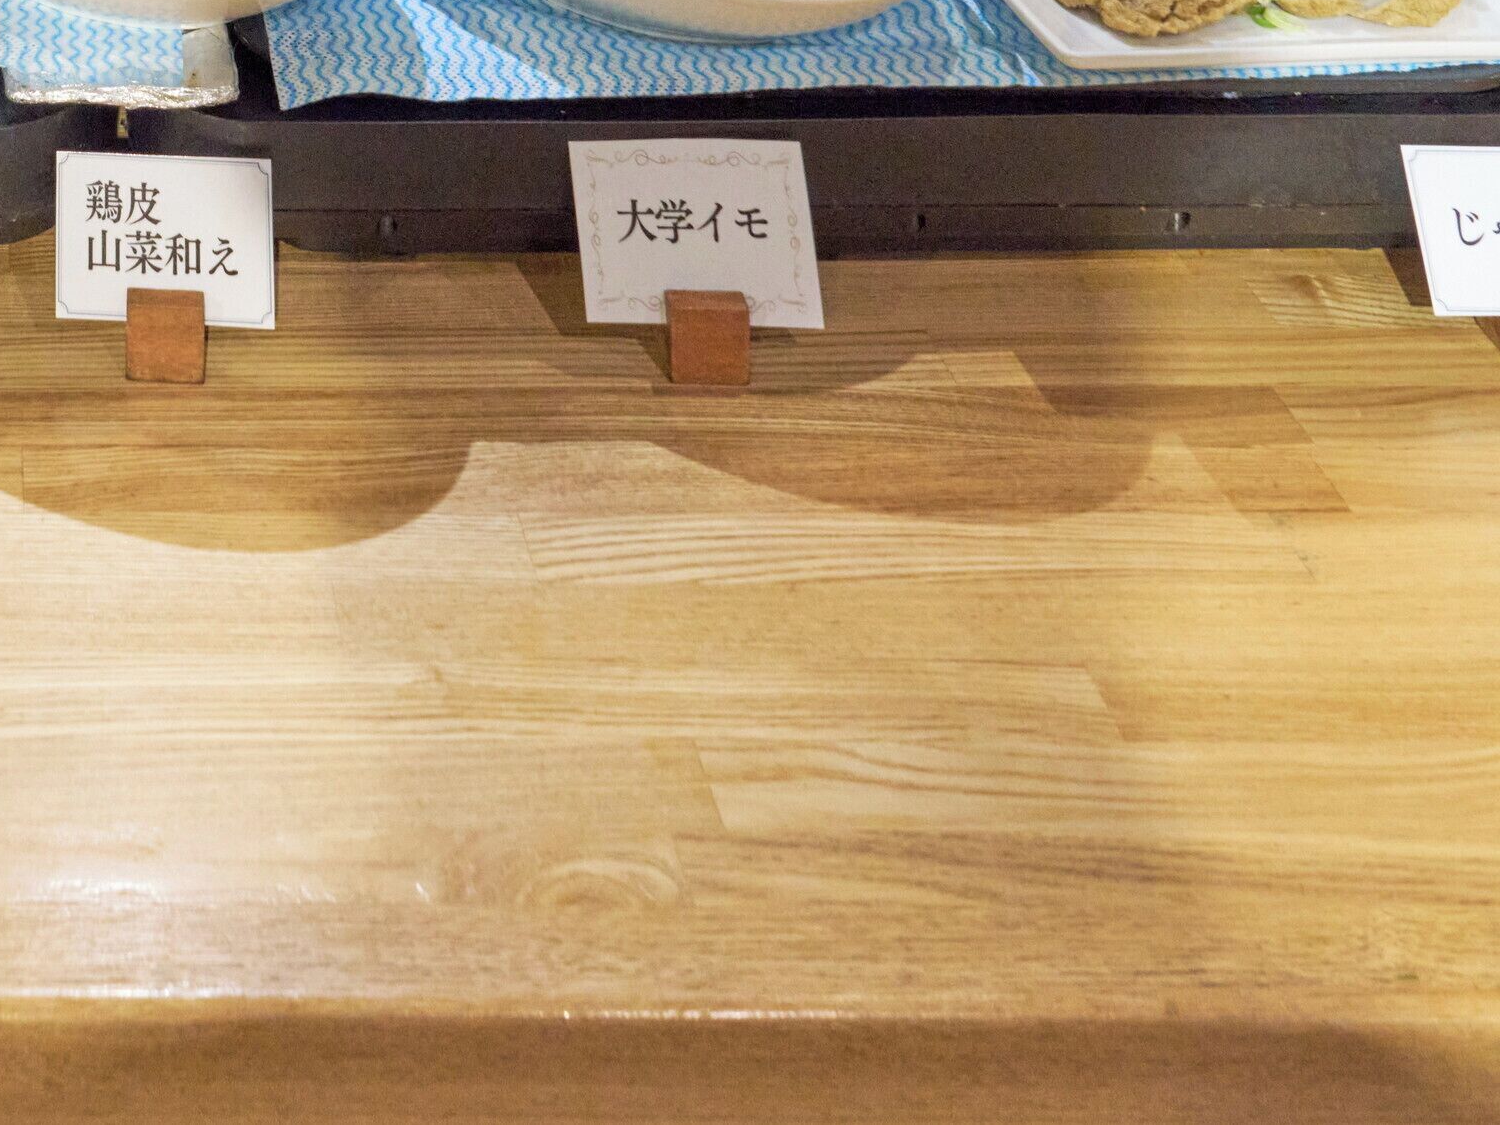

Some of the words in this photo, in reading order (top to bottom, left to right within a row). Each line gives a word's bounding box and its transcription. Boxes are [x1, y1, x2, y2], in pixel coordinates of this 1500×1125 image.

[85, 179, 162, 226] 鶏皮
[616, 198, 769, 244] 大学イモ
[1451, 207, 1500, 247] じ
[87, 229, 239, 276] 山菜和え
